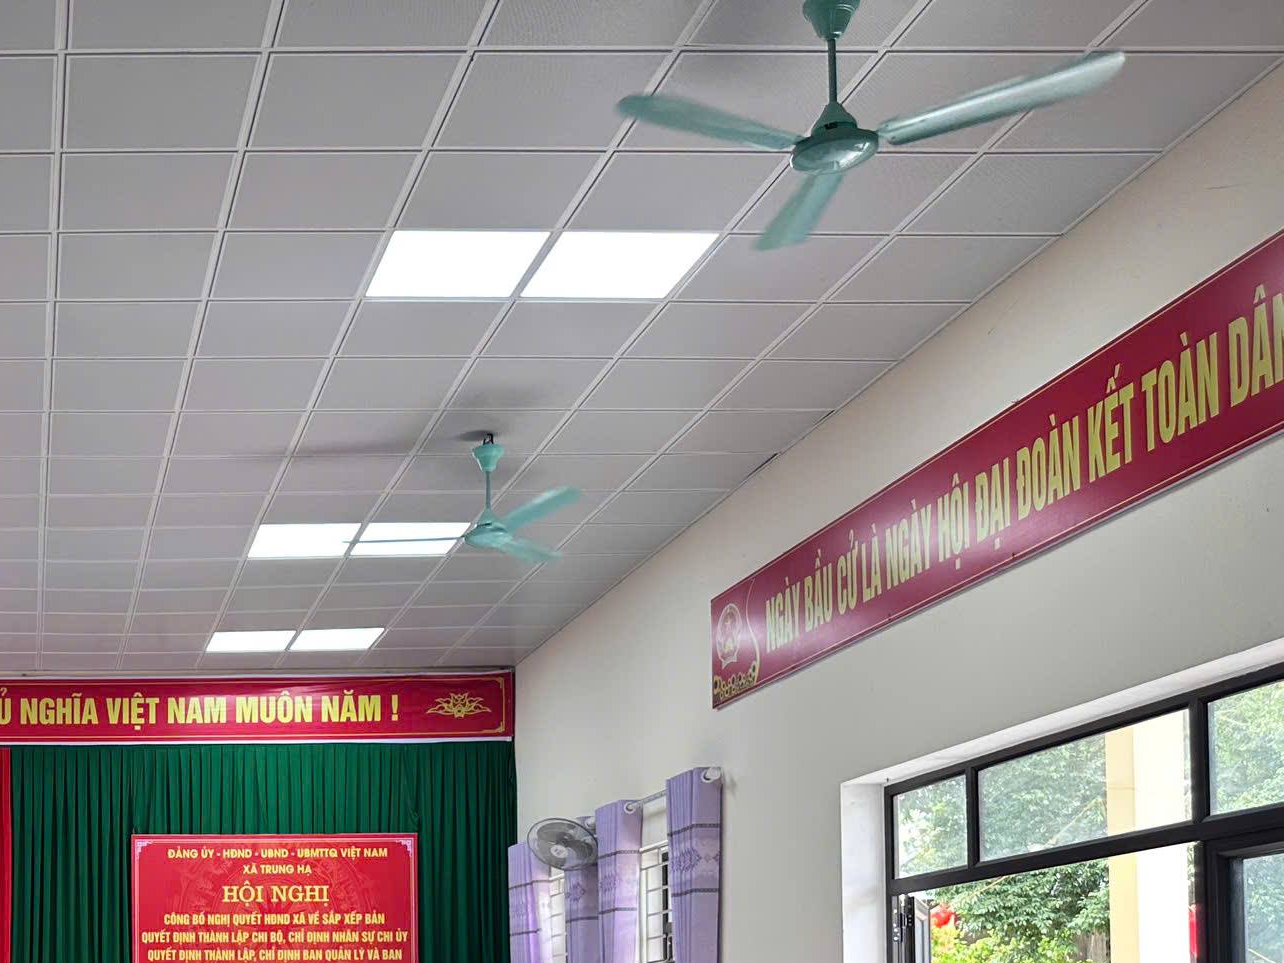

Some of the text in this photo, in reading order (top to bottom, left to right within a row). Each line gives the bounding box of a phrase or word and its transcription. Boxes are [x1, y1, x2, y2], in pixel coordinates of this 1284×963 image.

[766, 576, 800, 652] NGÀY
[804, 549, 833, 632] BẦU
[837, 529, 859, 615] CỬ
[861, 523, 882, 603] LÀ
[885, 498, 932, 590] NGÀY
[937, 472, 970, 570] HỘI
[974, 457, 1011, 551] ĐẠI
[1016, 413, 1081, 521] ĐOÀN
[1087, 362, 1134, 483] KẾT
[1141, 331, 1219, 452] TOÀN
[20, 692, 99, 725] NGHĨA
[107, 692, 159, 730] VIỆT
[168, 697, 226, 724] NAM
[236, 690, 313, 723] MUÔN
[321, 689, 381, 722] NĂM
[392, 694, 399, 721] !
[168, 847, 198, 859] ĐẢNG
[201, 847, 214, 858] ỦY
[223, 849, 252, 858] HĐND
[261, 849, 289, 858] UBND
[297, 849, 338, 859] UBMTTQ
[340, 846, 362, 860] VIỆT
[364, 848, 388, 857] NAM
[243, 863, 312, 876] XÃ TRUNG HẠ
[222, 880, 329, 906] HỘI NGHỊ
[164, 912, 190, 925] CÔNG
[192, 911, 205, 925] BỐ
[207, 913, 231, 927] NGHỊ
[233, 911, 262, 925] QUYẾT
[293, 912, 305, 924] XÃ
[308, 910, 320, 924] VỀ
[322, 910, 341, 924] SẮP
[344, 910, 362, 924] XẾP
[365, 910, 385, 924] BẢN
[141, 929, 171, 943] QUYẾT
[173, 931, 195, 945] ĐỊNH
[198, 930, 229, 943] THÀNH
[232, 930, 249, 945] LẬP
[252, 932, 267, 942] CHI
[288, 928, 304, 942] CHỈ
[307, 931, 329, 944] ĐỊNH
[332, 929, 358, 942] NHÂN
[362, 931, 376, 944] SỰ
[377, 931, 393, 942] CHI
[396, 928, 408, 942] ỦY
[148, 946, 176, 961] QUYẾT
[179, 949, 201, 963] ĐỊNH
[204, 948, 235, 960] THÀNH
[259, 946, 275, 960] CHỈ
[278, 949, 300, 963] ĐỊNH
[303, 949, 322, 960] BAN
[325, 946, 351, 961] QUẢN
[367, 947, 380, 960] VÀ
[382, 949, 402, 960] BAN
